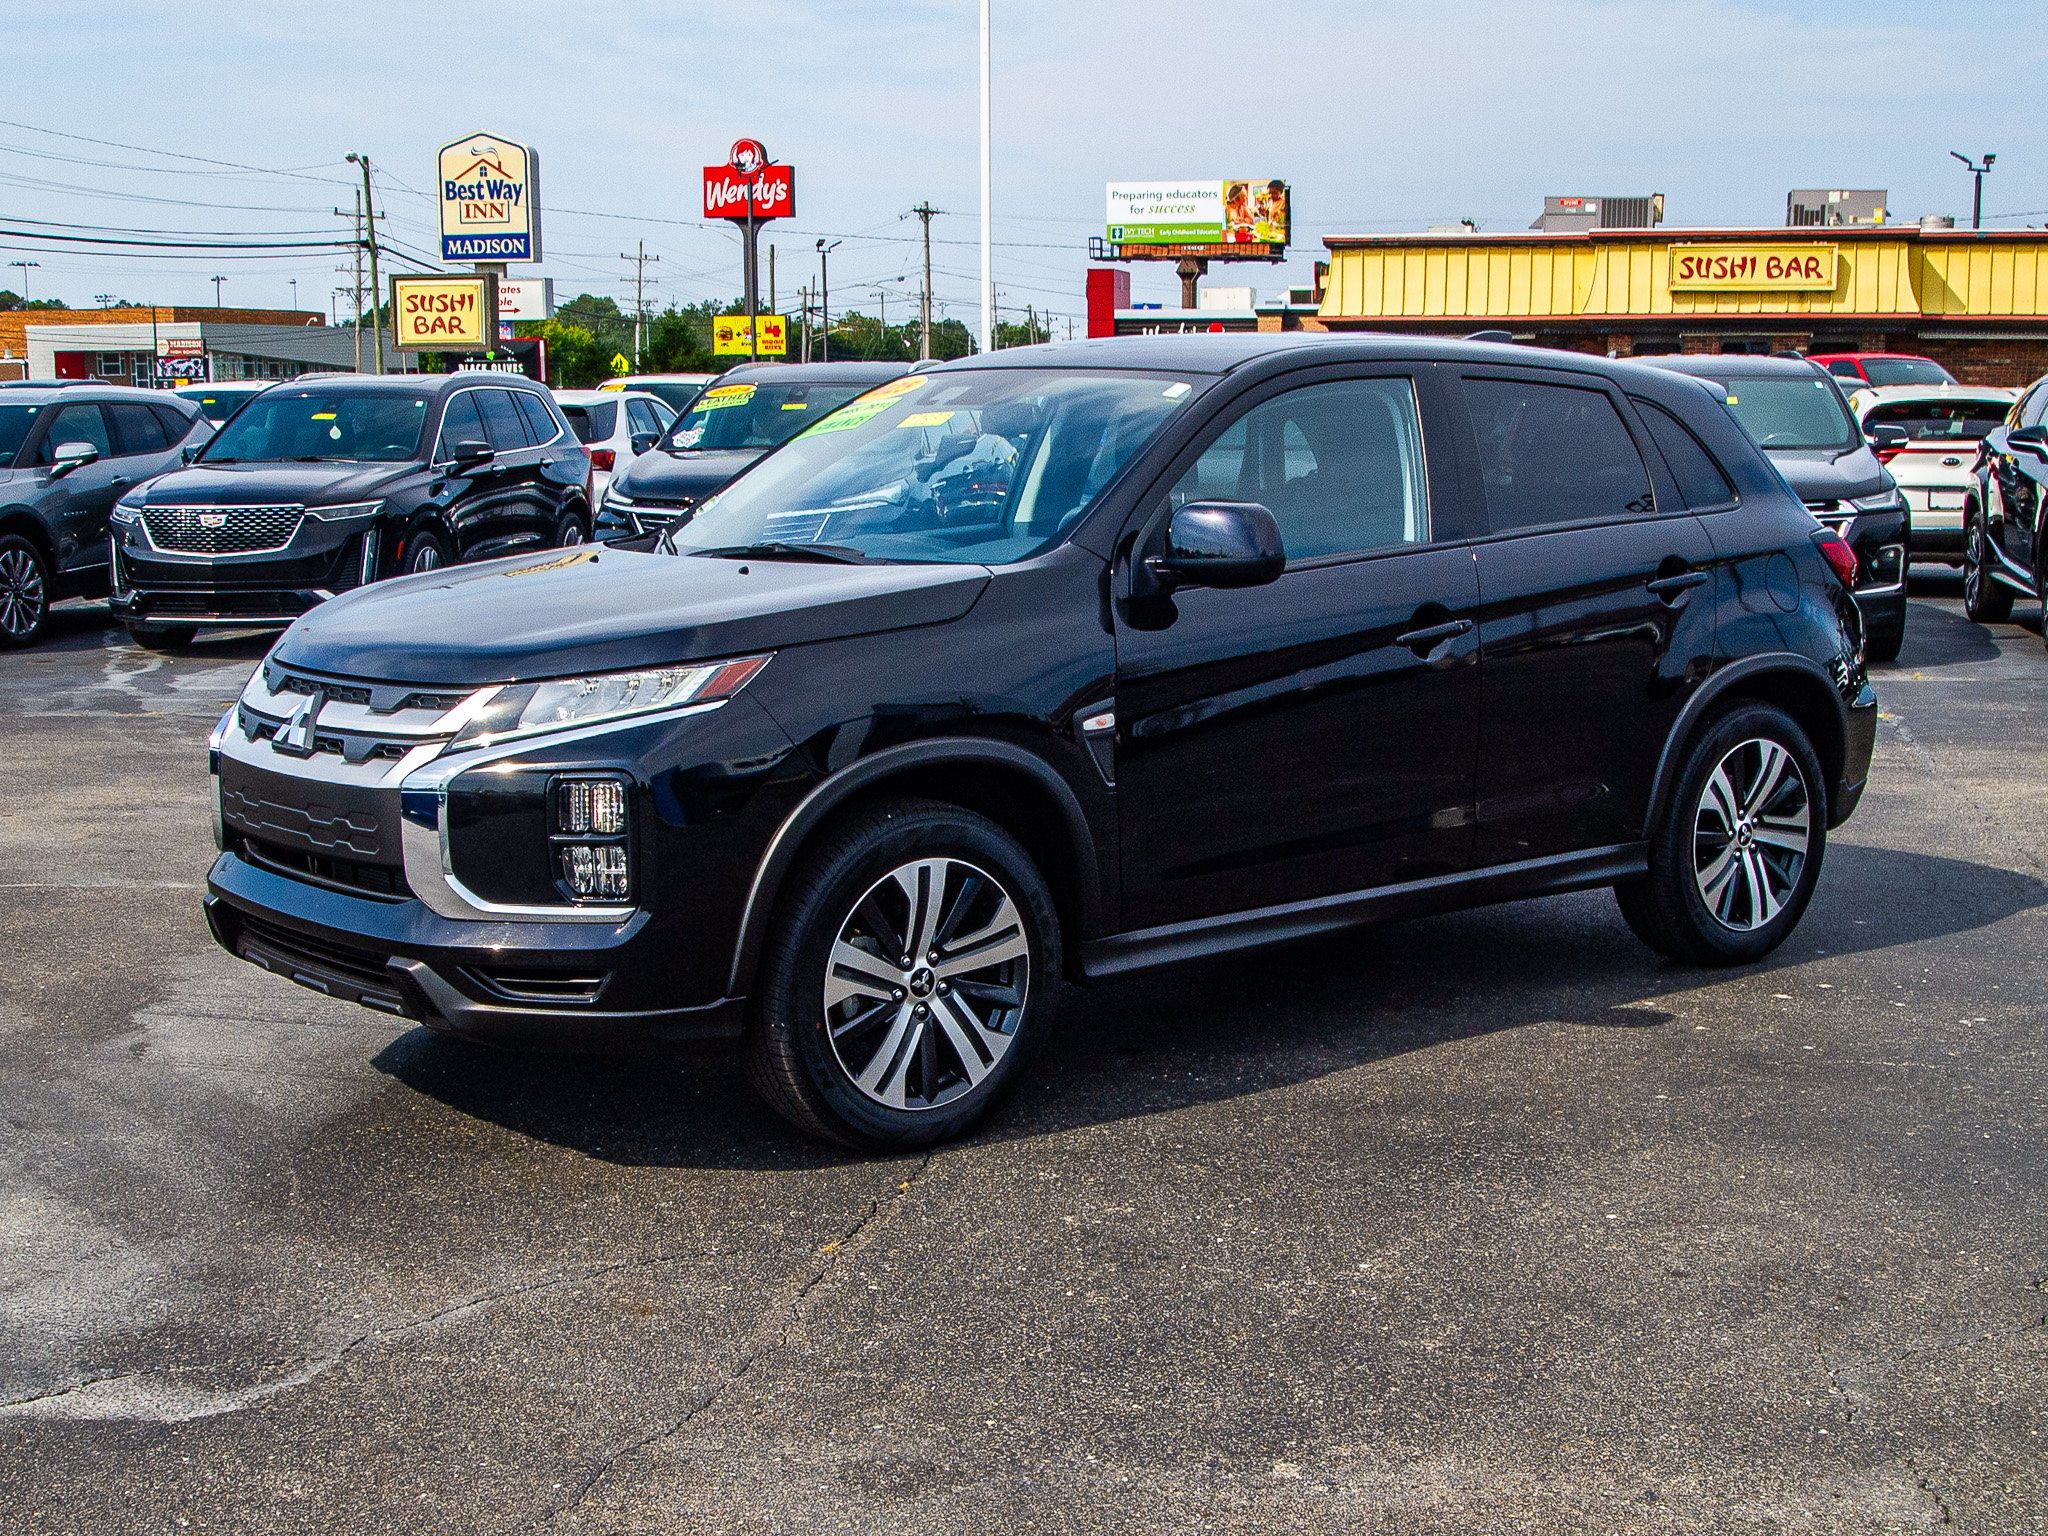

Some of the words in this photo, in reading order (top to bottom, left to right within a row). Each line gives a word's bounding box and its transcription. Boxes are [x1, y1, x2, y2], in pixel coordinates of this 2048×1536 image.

[445, 180, 484, 201] Best
[486, 179, 523, 207] Way
[706, 173, 788, 211] Wendy's
[1112, 190, 1163, 202] Preparing
[1166, 189, 1218, 199] educators
[464, 203, 504, 219] INN
[1130, 204, 1144, 214] for
[1148, 204, 1196, 214] success
[447, 239, 525, 255] MADISON
[1679, 256, 1757, 280] SUSHI
[1766, 256, 1824, 279] BAR
[498, 286, 521, 294] ates
[405, 293, 474, 313] SUSHI
[413, 316, 466, 335] BAR
